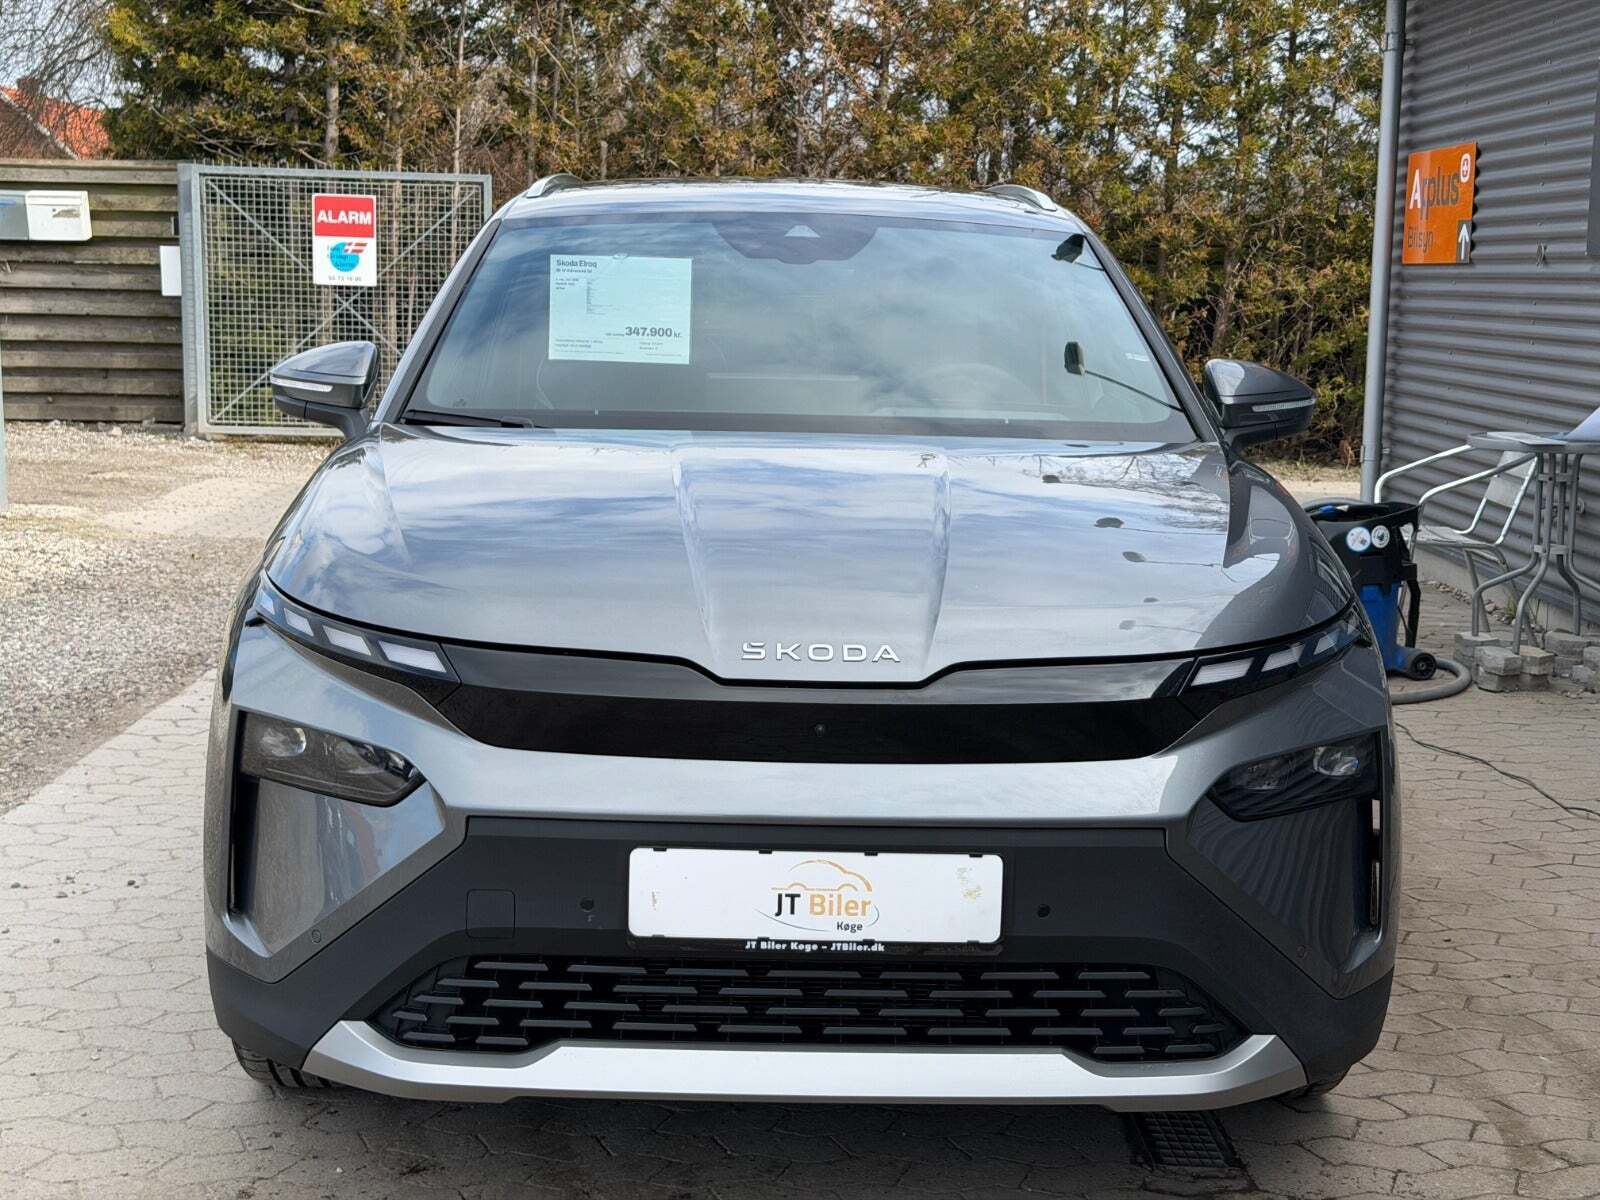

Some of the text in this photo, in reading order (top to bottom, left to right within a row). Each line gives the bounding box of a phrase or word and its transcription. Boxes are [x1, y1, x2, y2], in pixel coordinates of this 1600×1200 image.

[317, 210, 372, 225] ALARM
[556, 259, 597, 269] Skoda Elroq
[625, 326, 673, 338] 347.900
[741, 642, 902, 663] SKODA
[775, 893, 872, 917] JT Biler
[836, 921, 863, 934] Køge
[745, 941, 757, 950] JT
[760, 941, 787, 951] Biler
[830, 943, 885, 953] JTBiler.dk
